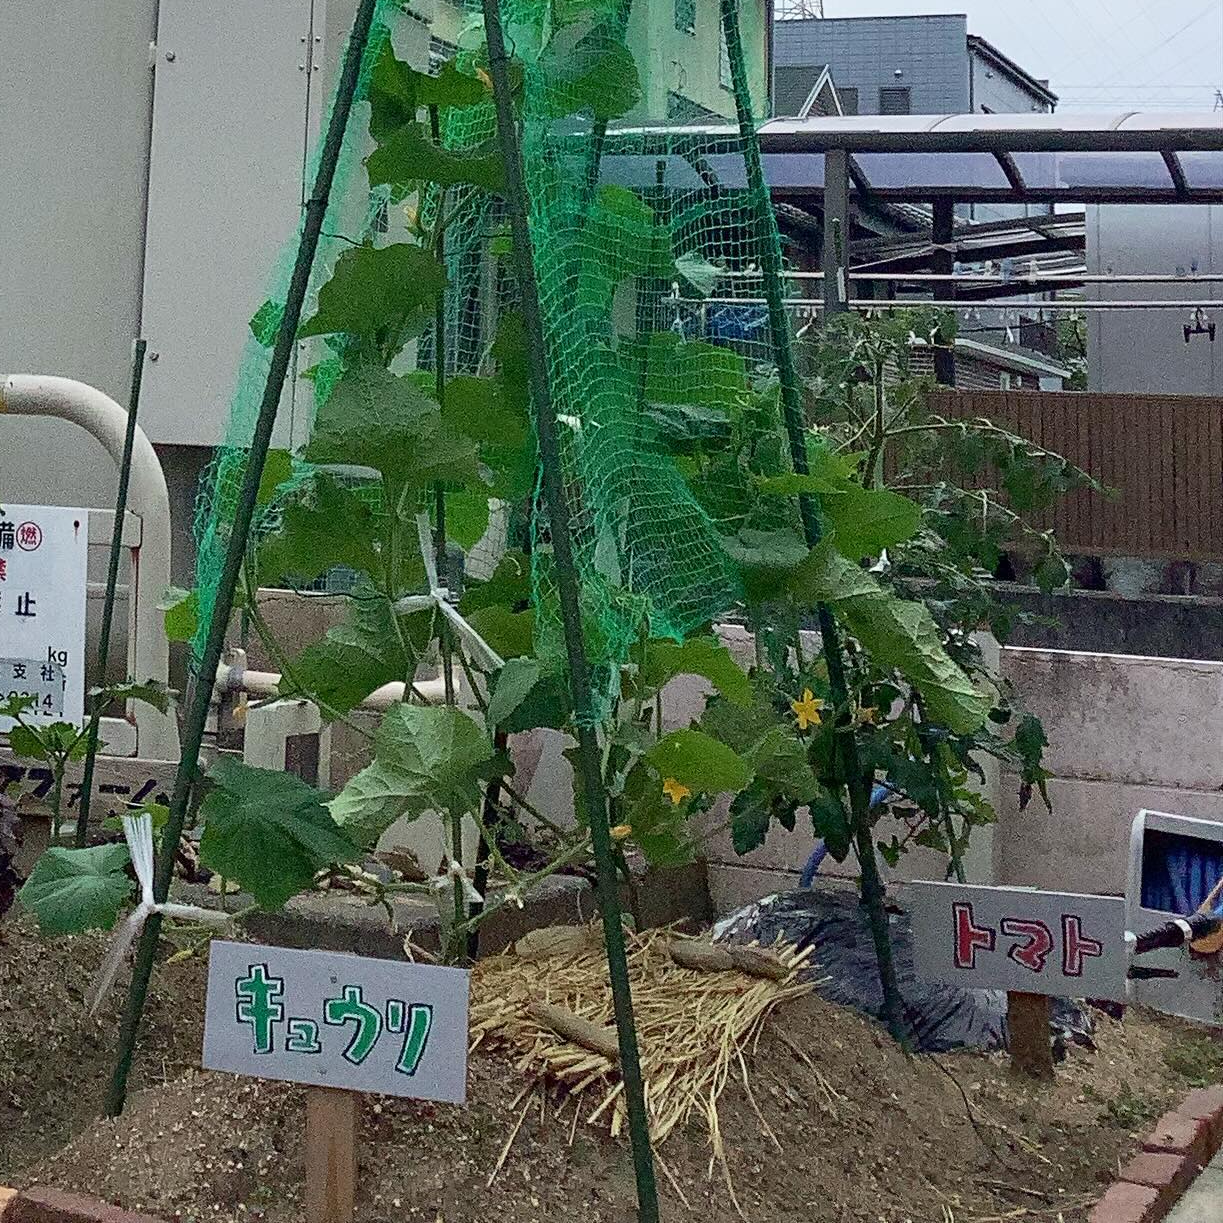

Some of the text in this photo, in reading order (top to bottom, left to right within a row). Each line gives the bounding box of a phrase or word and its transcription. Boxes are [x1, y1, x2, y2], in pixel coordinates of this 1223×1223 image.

[48, 646, 68, 667] kg
[952, 901, 1103, 976] トマト
[235, 963, 433, 1076] キュウリ
